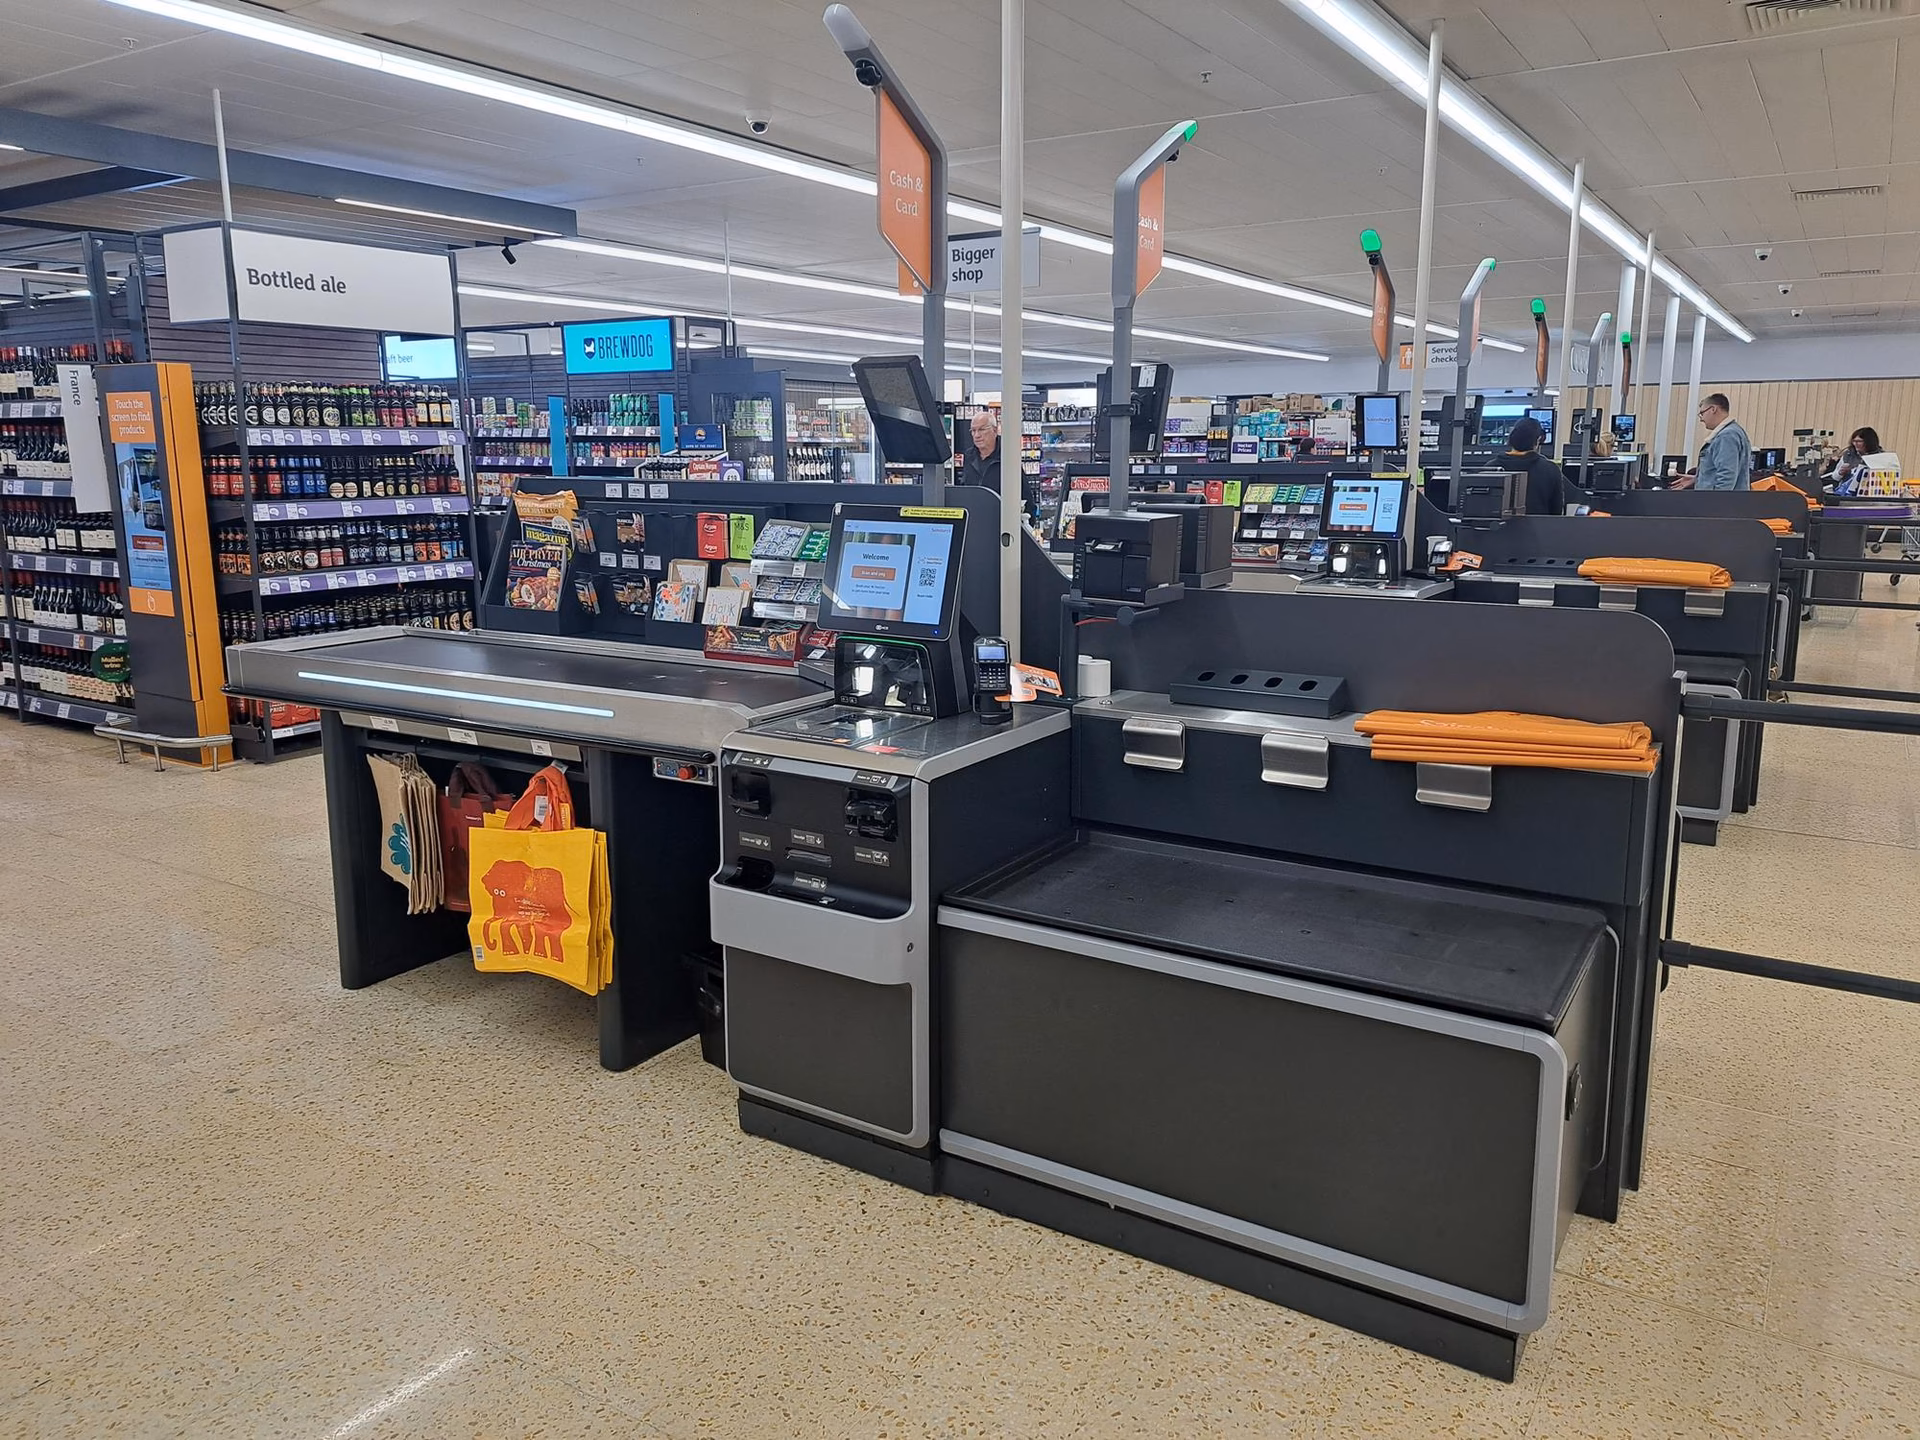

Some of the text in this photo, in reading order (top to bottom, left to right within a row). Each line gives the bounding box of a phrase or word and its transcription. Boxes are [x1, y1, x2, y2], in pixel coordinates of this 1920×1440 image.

[889, 170, 924, 192] Cash &
[895, 198, 919, 217] Card
[951, 247, 996, 265] Bigger
[246, 268, 347, 294] Bottled ale
[951, 267, 984, 284] shop
[597, 333, 654, 360] BREWDOG
[69, 370, 82, 406] France
[115, 400, 145, 409] Touch the
[111, 411, 150, 422] screen to find
[119, 425, 146, 437] products
[734, 522, 750, 532] M&S
[526, 530, 569, 545] magazine
[516, 557, 552, 569] Christmas
[862, 553, 890, 562] Welcome
